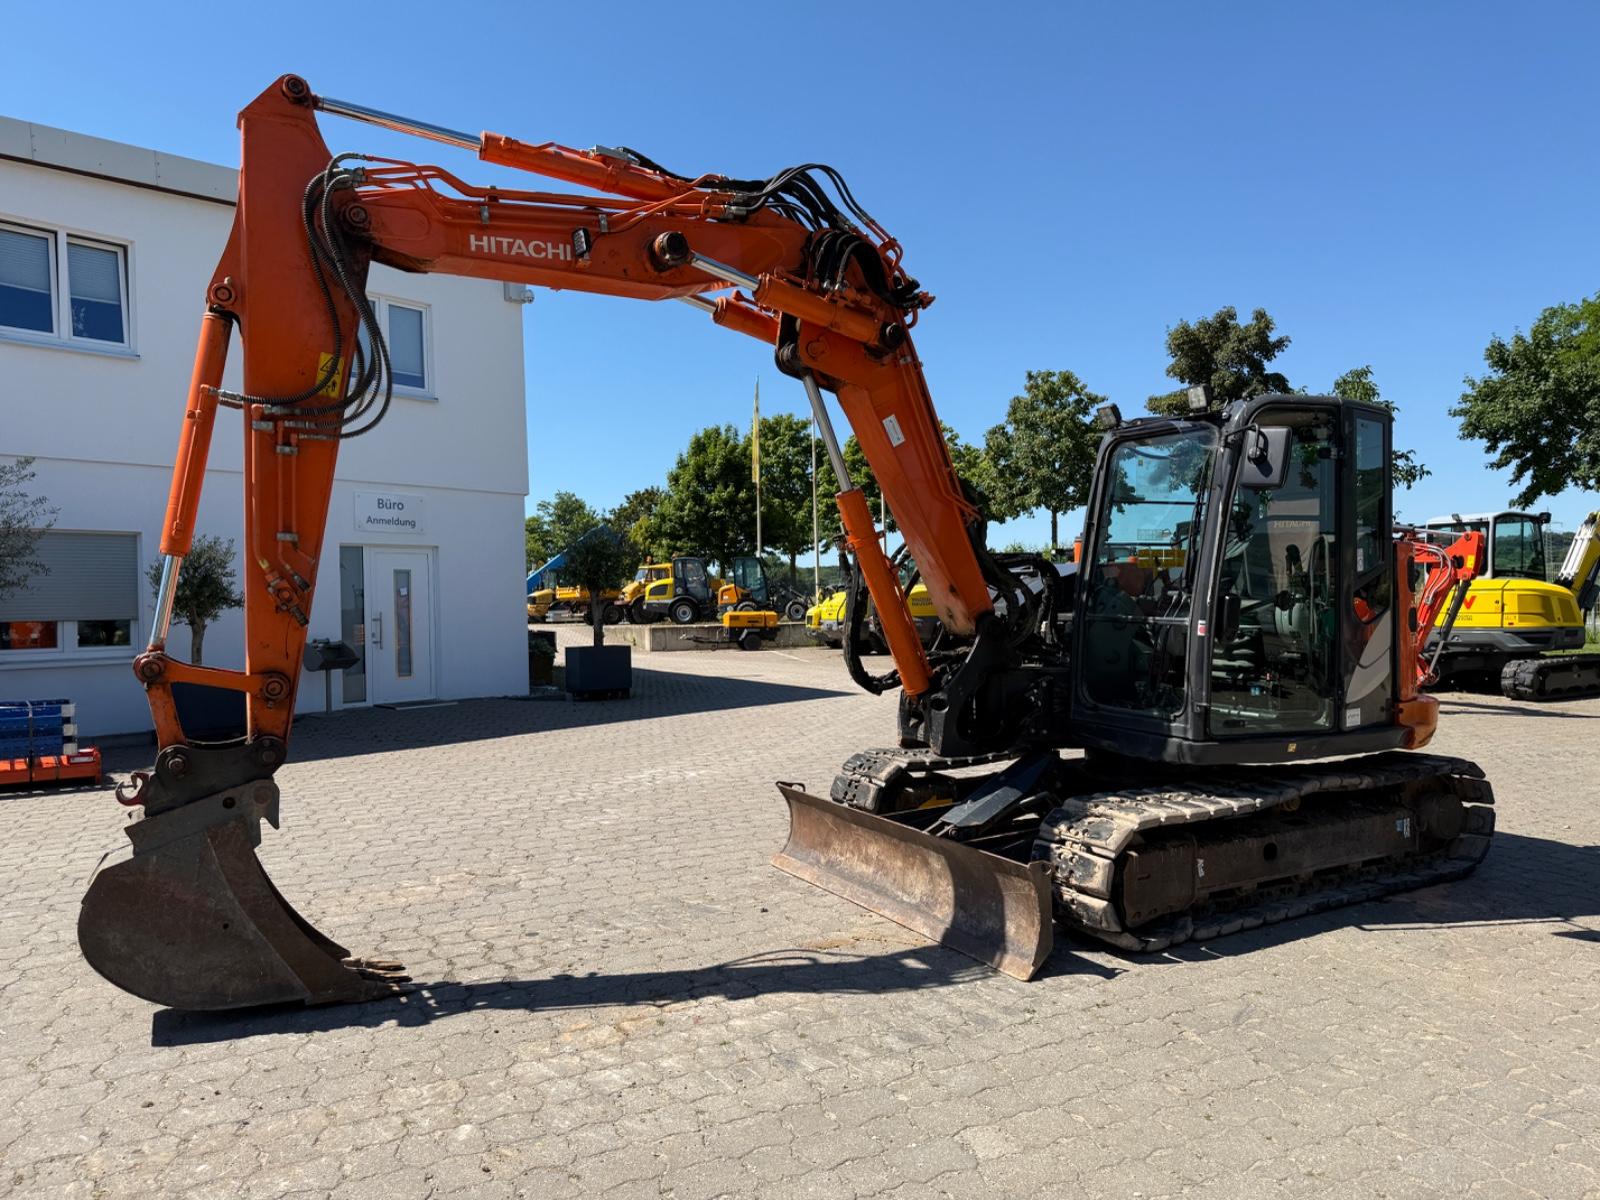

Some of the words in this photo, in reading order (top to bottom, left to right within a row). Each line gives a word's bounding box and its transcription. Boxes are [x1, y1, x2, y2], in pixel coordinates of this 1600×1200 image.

[469, 234, 572, 261] HITACHI
[377, 498, 404, 511] Büro
[366, 515, 416, 529] Anmeldung
